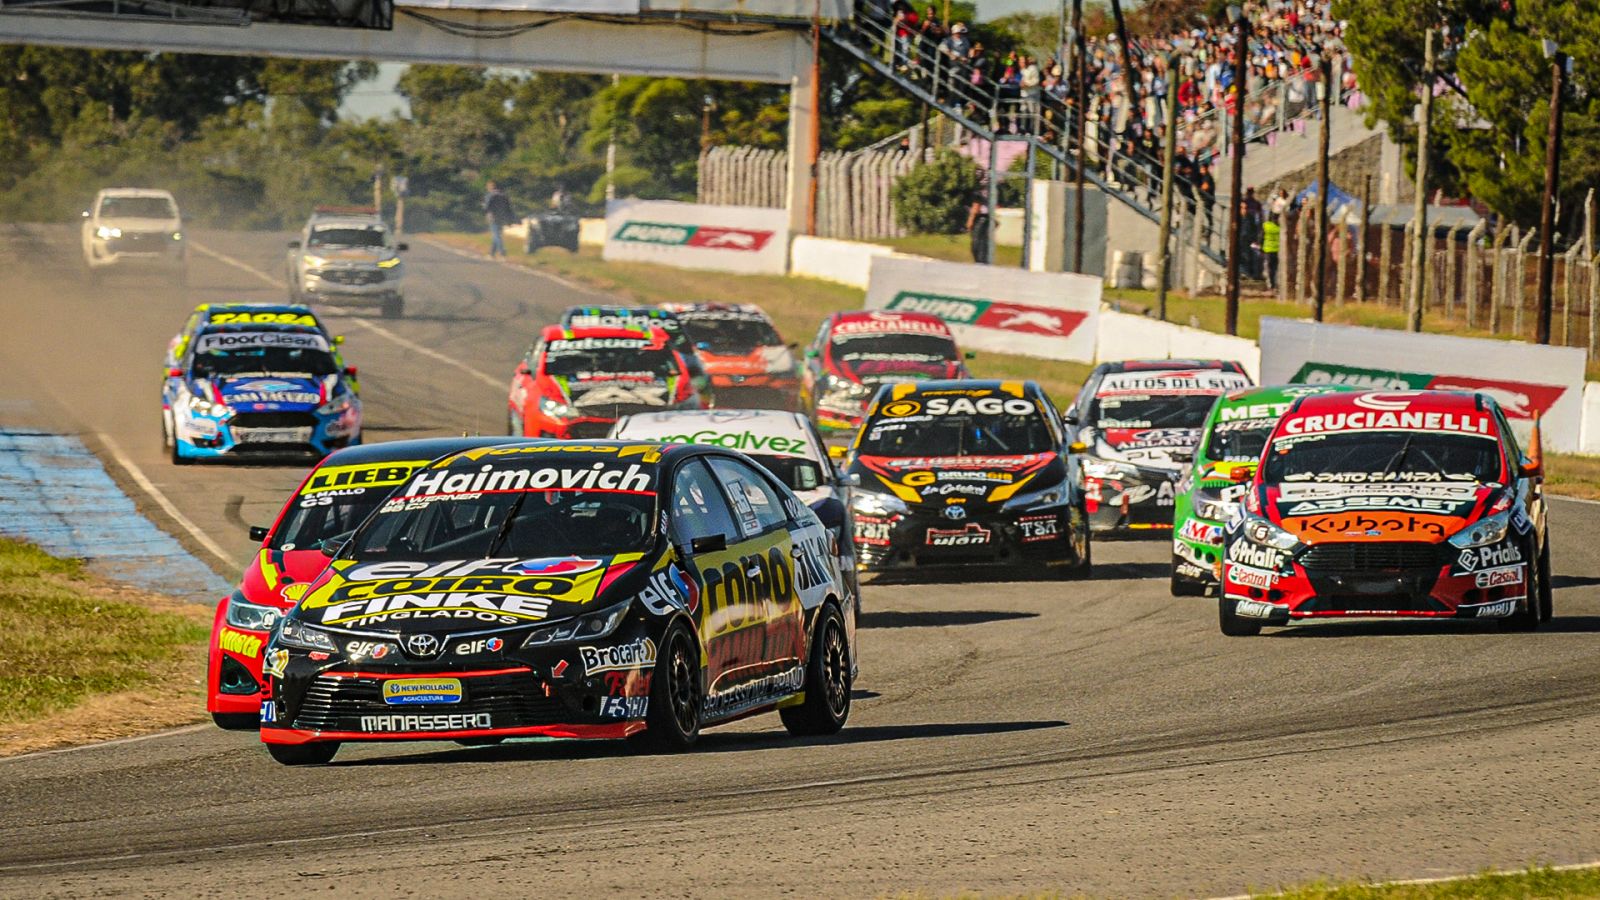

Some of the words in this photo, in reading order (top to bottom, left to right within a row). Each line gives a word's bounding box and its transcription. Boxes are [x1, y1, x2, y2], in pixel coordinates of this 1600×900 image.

[211, 312, 317, 327] TAOSA
[834, 319, 946, 334] CRUCIANELLI
[205, 334, 319, 348] FloorClean
[1109, 378, 1167, 391] AUTOS
[1171, 378, 1201, 390] DEL
[1208, 378, 1245, 390] SUR
[925, 398, 1036, 416] SAGO
[1285, 412, 1489, 434] CRUCIANELLI
[404, 462, 652, 497] Haimovich
[1313, 472, 1368, 483] PATO
[299, 496, 334, 508] C3
[409, 493, 483, 504] WERNER
[1289, 496, 1467, 512] ARSEMET
[1301, 515, 1446, 538] Kubota
[1479, 541, 1522, 567] Prialis
[346, 557, 520, 582] elf
[1489, 567, 1519, 586] Castrol
[326, 577, 576, 603] COIRO
[637, 572, 684, 616] elf
[321, 593, 553, 625] FINKE
[343, 610, 519, 629] TINGLADOS
[345, 639, 375, 656] elf
[455, 639, 486, 655] elf
[583, 640, 645, 669] Brocart
[401, 684, 419, 693] NEW
[419, 683, 455, 692] HOLLAND
[402, 694, 444, 703] AGRICULTURE
[360, 712, 492, 731] MANASSERO
